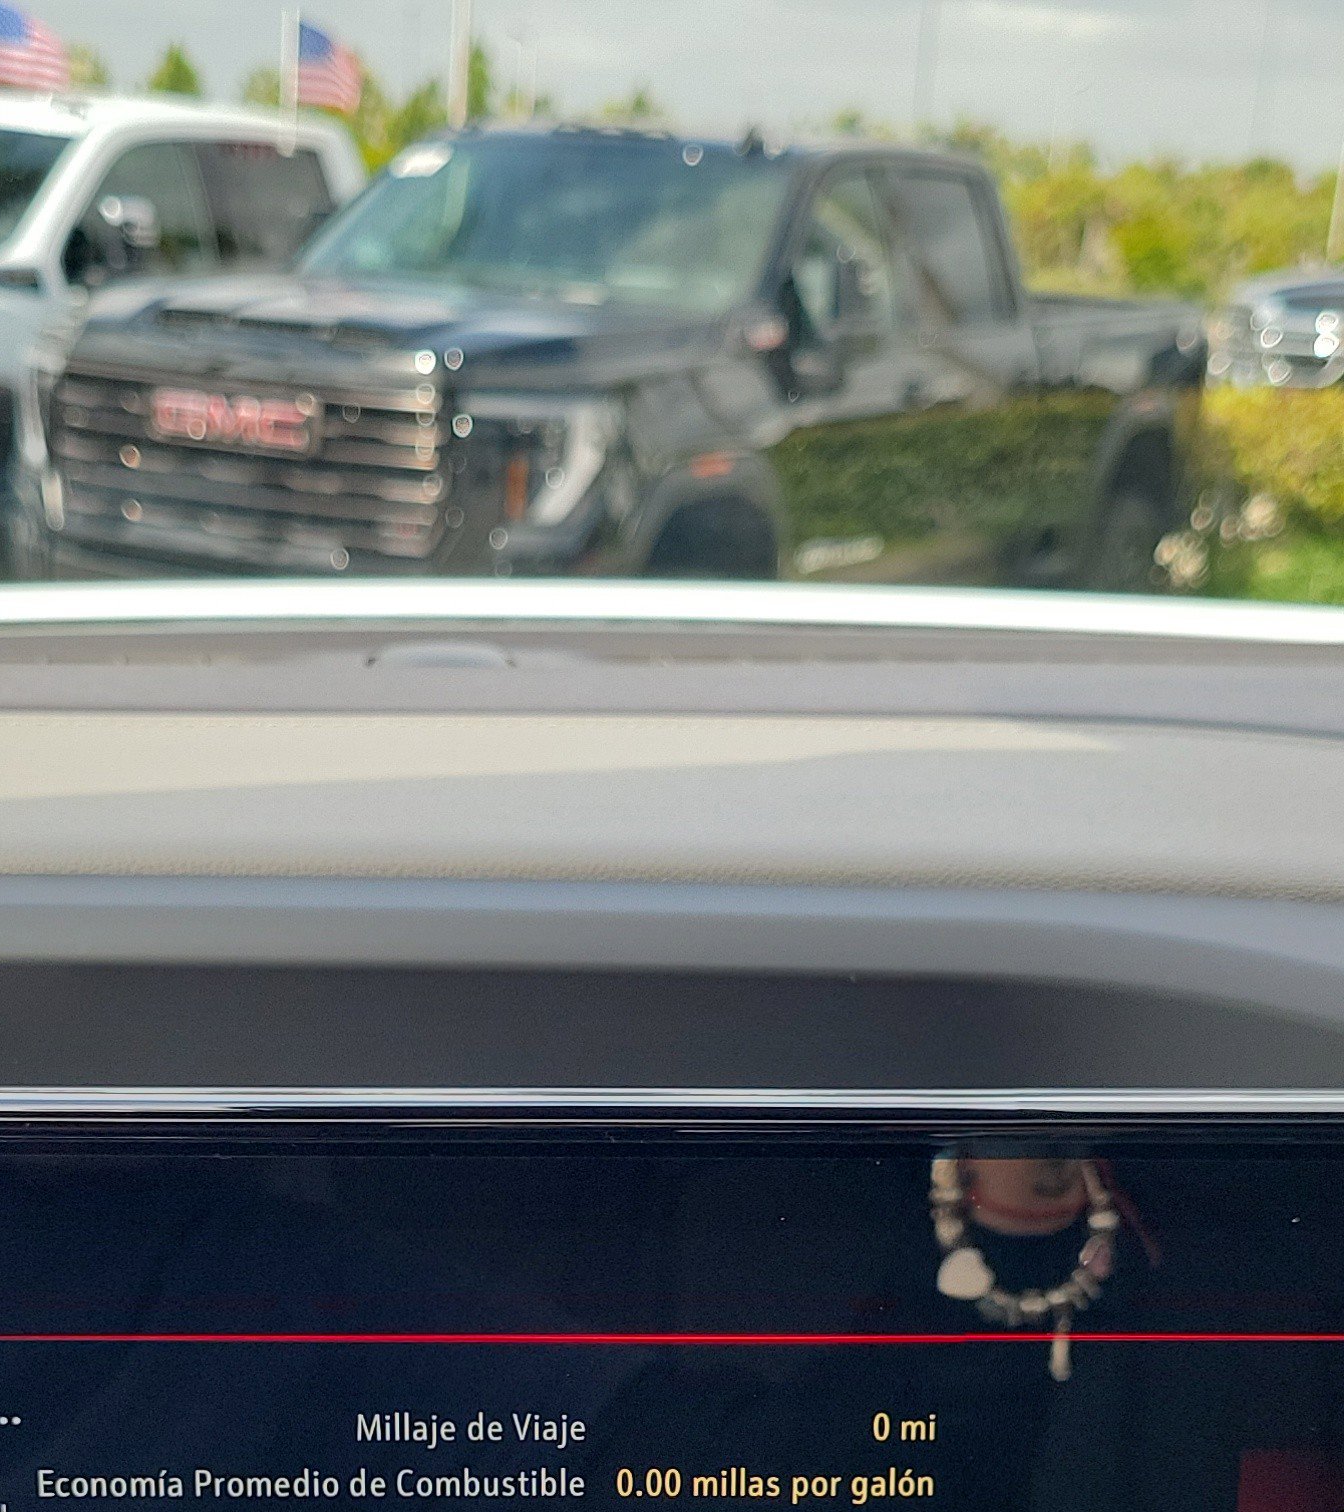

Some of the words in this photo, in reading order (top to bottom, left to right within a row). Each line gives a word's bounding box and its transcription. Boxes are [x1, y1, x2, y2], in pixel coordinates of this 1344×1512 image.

[356, 1411, 456, 1450] Millaje
[467, 1411, 503, 1441] de
[511, 1411, 587, 1449] Viaje
[873, 1412, 890, 1441] 0
[900, 1414, 936, 1441] mi
[37, 1469, 183, 1498] Economía
[194, 1467, 339, 1498] Promedio
[349, 1467, 386, 1497] de
[396, 1467, 585, 1497] Combustible
[616, 1468, 681, 1497] 0.00
[693, 1467, 780, 1497] millas
[791, 1476, 842, 1505] por
[851, 1466, 934, 1505] galón
